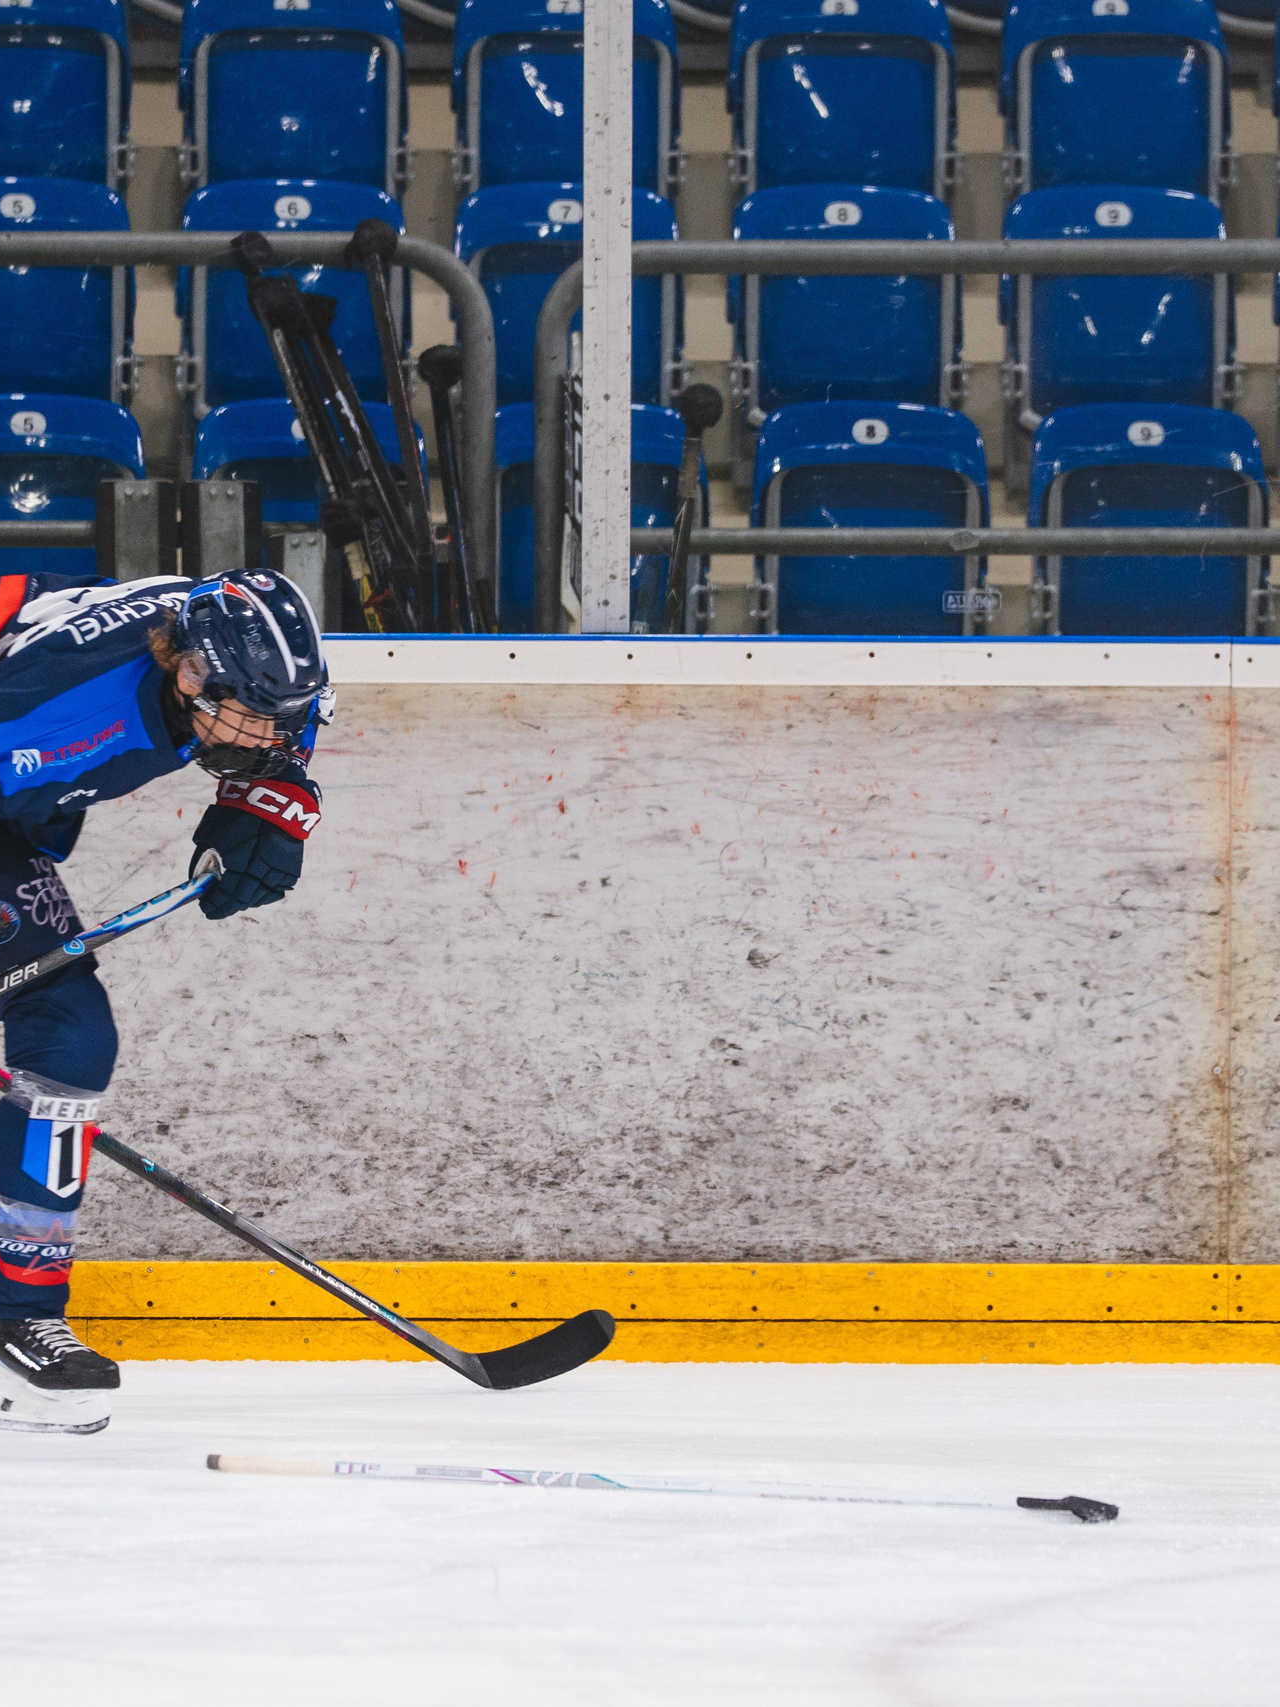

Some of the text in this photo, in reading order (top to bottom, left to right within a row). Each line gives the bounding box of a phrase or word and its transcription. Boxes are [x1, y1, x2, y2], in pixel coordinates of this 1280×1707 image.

[12, 200, 23, 215] 5
[287, 202, 298, 216] 6
[561, 205, 571, 220] 7
[837, 207, 848, 222] 8
[1108, 208, 1120, 223] 9
[23, 417, 34, 432] 5
[865, 424, 876, 439] 8
[1141, 427, 1152, 441] 9
[40, 719, 126, 764] STRUWE
[220, 780, 321, 832] CCM
